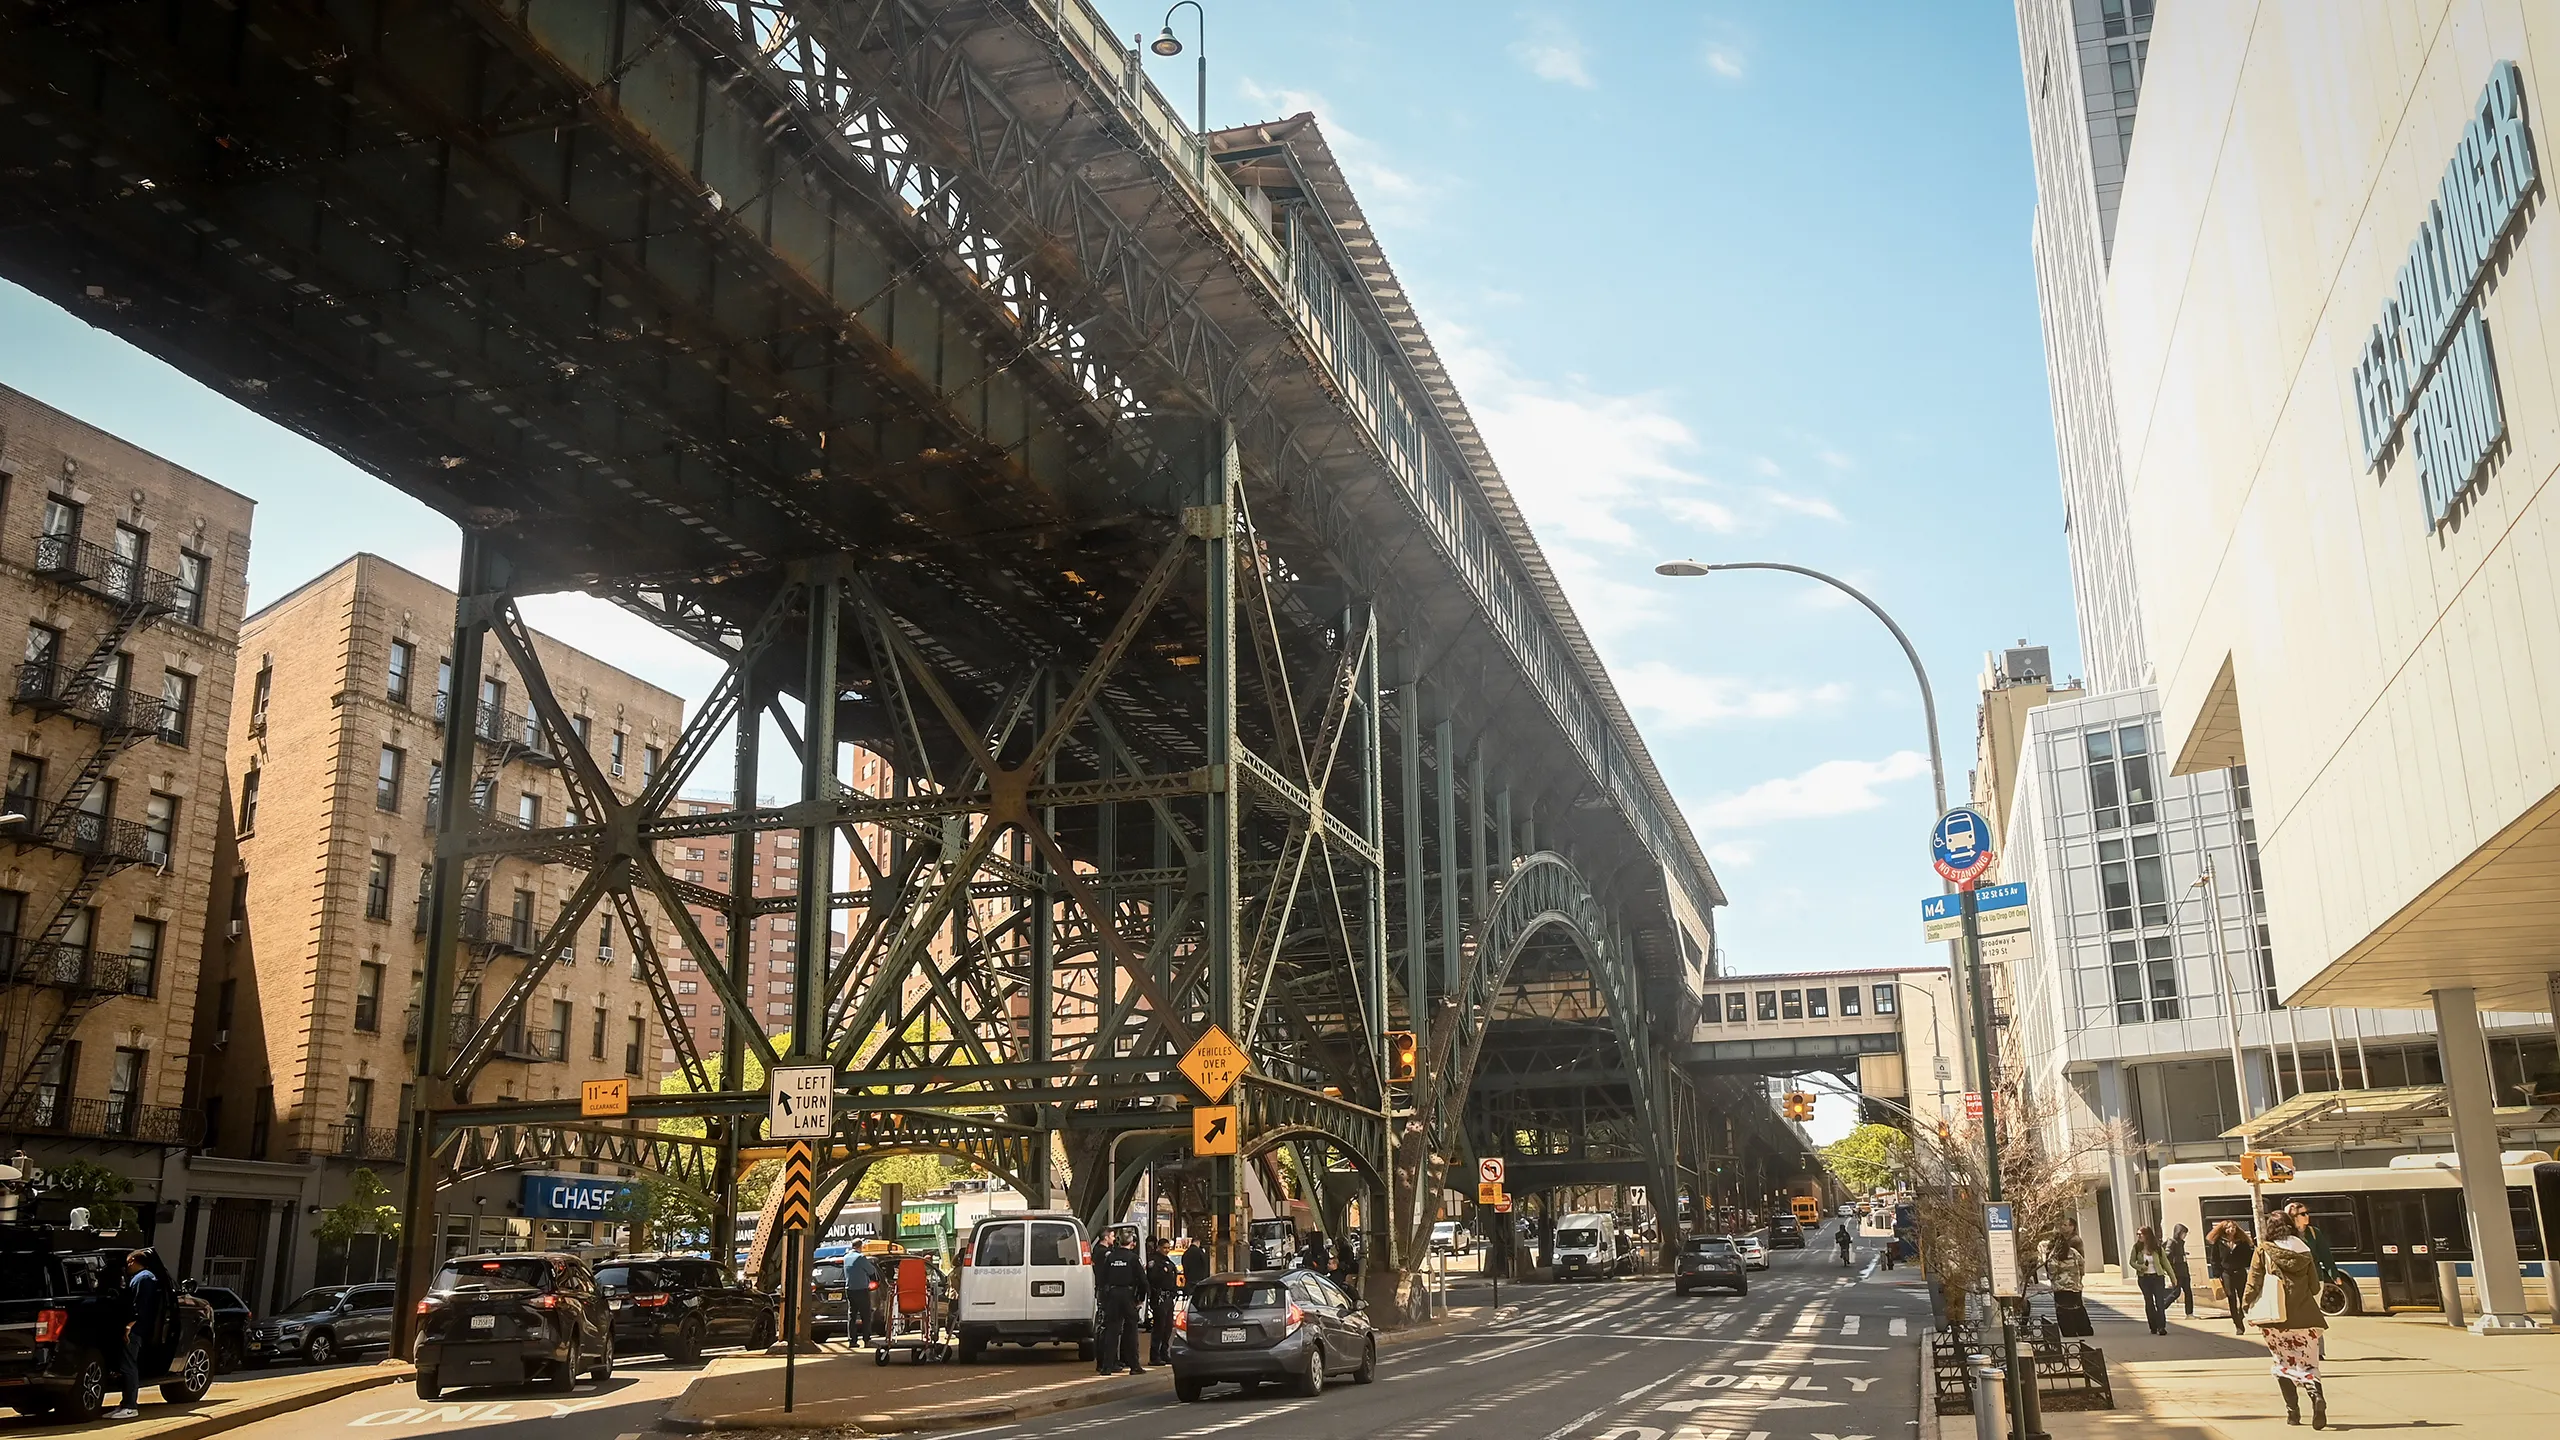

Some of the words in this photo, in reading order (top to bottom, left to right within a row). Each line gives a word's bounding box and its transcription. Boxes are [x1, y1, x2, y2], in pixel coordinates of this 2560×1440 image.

[2352, 322, 2396, 475] LEE
[2395, 59, 2536, 390] BOLLINGER
[2409, 306, 2502, 537] FORUM
[1937, 863, 1949, 875] NO
[1951, 855, 1989, 879] STANDING
[1976, 893, 1981, 901] E
[1981, 892, 1990, 900] 32
[1990, 891, 1998, 899] St
[2010, 887, 2018, 895] Av
[1924, 899, 1946, 918] M4
[2015, 909, 2027, 918] Only
[1980, 938, 2010, 948] Broadway
[1981, 950, 1988, 958] W
[1988, 948, 2000, 957] 129
[2001, 947, 2008, 955] St
[1197, 1046, 1232, 1057] VEHICLES
[1203, 1059, 1226, 1069] OVER
[797, 1076, 827, 1090] LEFT
[589, 1103, 620, 1111] CLEARANCE
[796, 1095, 827, 1109] TURN
[794, 1115, 826, 1129] LANE
[552, 1186, 615, 1211] CHASE
[901, 1209, 946, 1227] SUBWAY
[848, 1222, 875, 1237] GRILL
[1689, 1374, 1883, 1392] ONLY
[347, 1400, 607, 1427] ONLY
